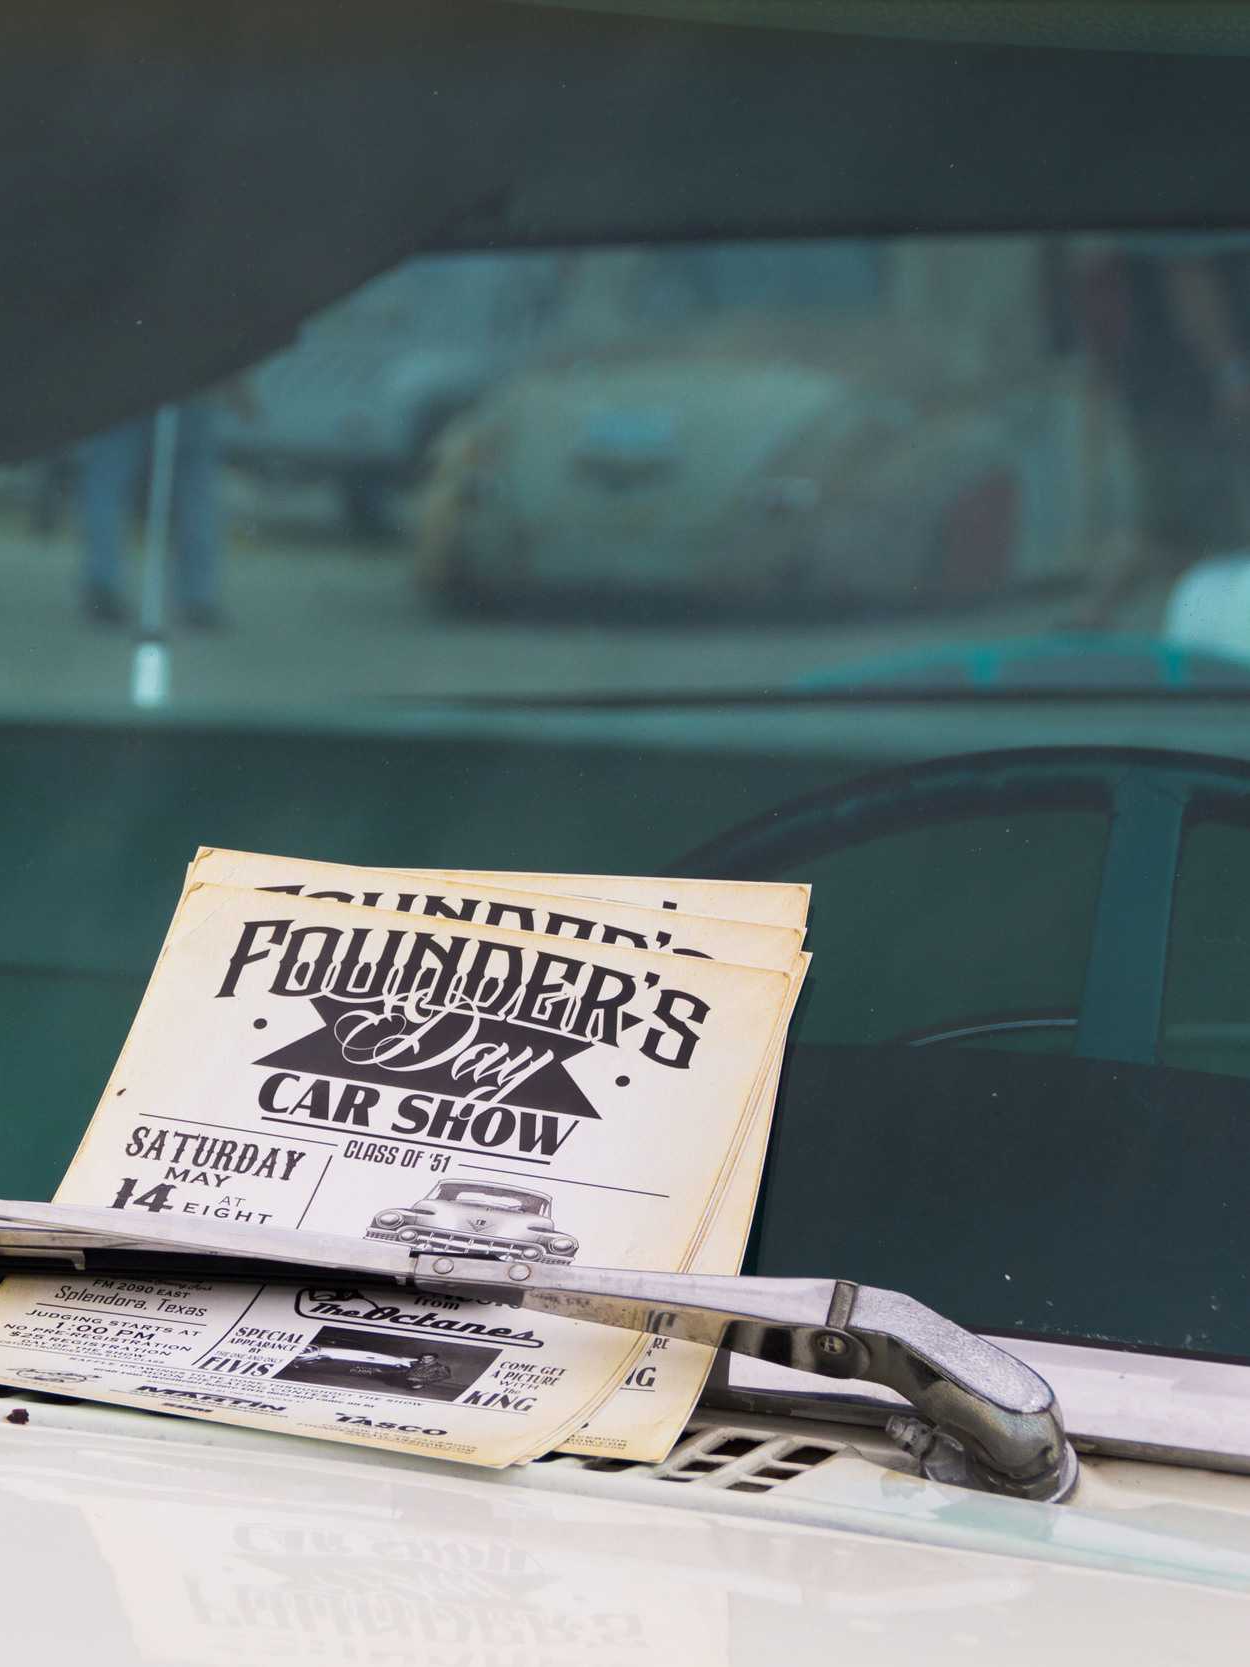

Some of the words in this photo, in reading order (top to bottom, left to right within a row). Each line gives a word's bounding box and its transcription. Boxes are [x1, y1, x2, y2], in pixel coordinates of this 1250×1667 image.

[214, 919, 711, 1069] FOUNDER'S
[334, 992, 553, 1118] Day
[258, 1072, 380, 1127] CAR
[391, 1094, 580, 1156] SHOW
[125, 1126, 307, 1182] SATURDAY
[343, 1140, 397, 1167] CLASS
[400, 1149, 425, 1169] OF
[428, 1152, 452, 1173] '51
[164, 1166, 232, 1189] MAY
[106, 1177, 177, 1213] 14
[219, 1194, 247, 1208] AT
[182, 1202, 273, 1226] EIGHT
[92, 1279, 113, 1289] FM
[117, 1282, 153, 1295] 2090
[156, 1288, 191, 1299] EAST
[54, 1285, 148, 1311] Splendora,
[156, 1297, 208, 1318] Texas
[413, 1295, 460, 1311] from
[25, 1309, 103, 1325] JUDGING
[108, 1320, 175, 1334] STARTS
[178, 1329, 203, 1338] AT
[55, 1320, 108, 1335] 1:00
[115, 1329, 156, 1341] PM
[308, 1302, 360, 1319] The
[360, 1306, 534, 1341] Octanes
[4, 1323, 28, 1331] NO
[32, 1327, 193, 1352] PRE-REGISTRATION
[9, 1331, 44, 1341] $25
[48, 1336, 173, 1357] REGISTRATION
[228, 1337, 298, 1352] APPEARANCE
[235, 1326, 305, 1344] SPECIAL
[198, 1356, 275, 1377] ELVIS
[492, 1369, 501, 1378] A
[505, 1370, 561, 1386] PICTURE
[500, 1361, 535, 1375] COME
[540, 1365, 569, 1377] GET
[498, 1379, 541, 1391] WITH
[136, 1384, 287, 1412] MARTIN
[462, 1390, 538, 1412] KING
[335, 1412, 448, 1436] TASCO
